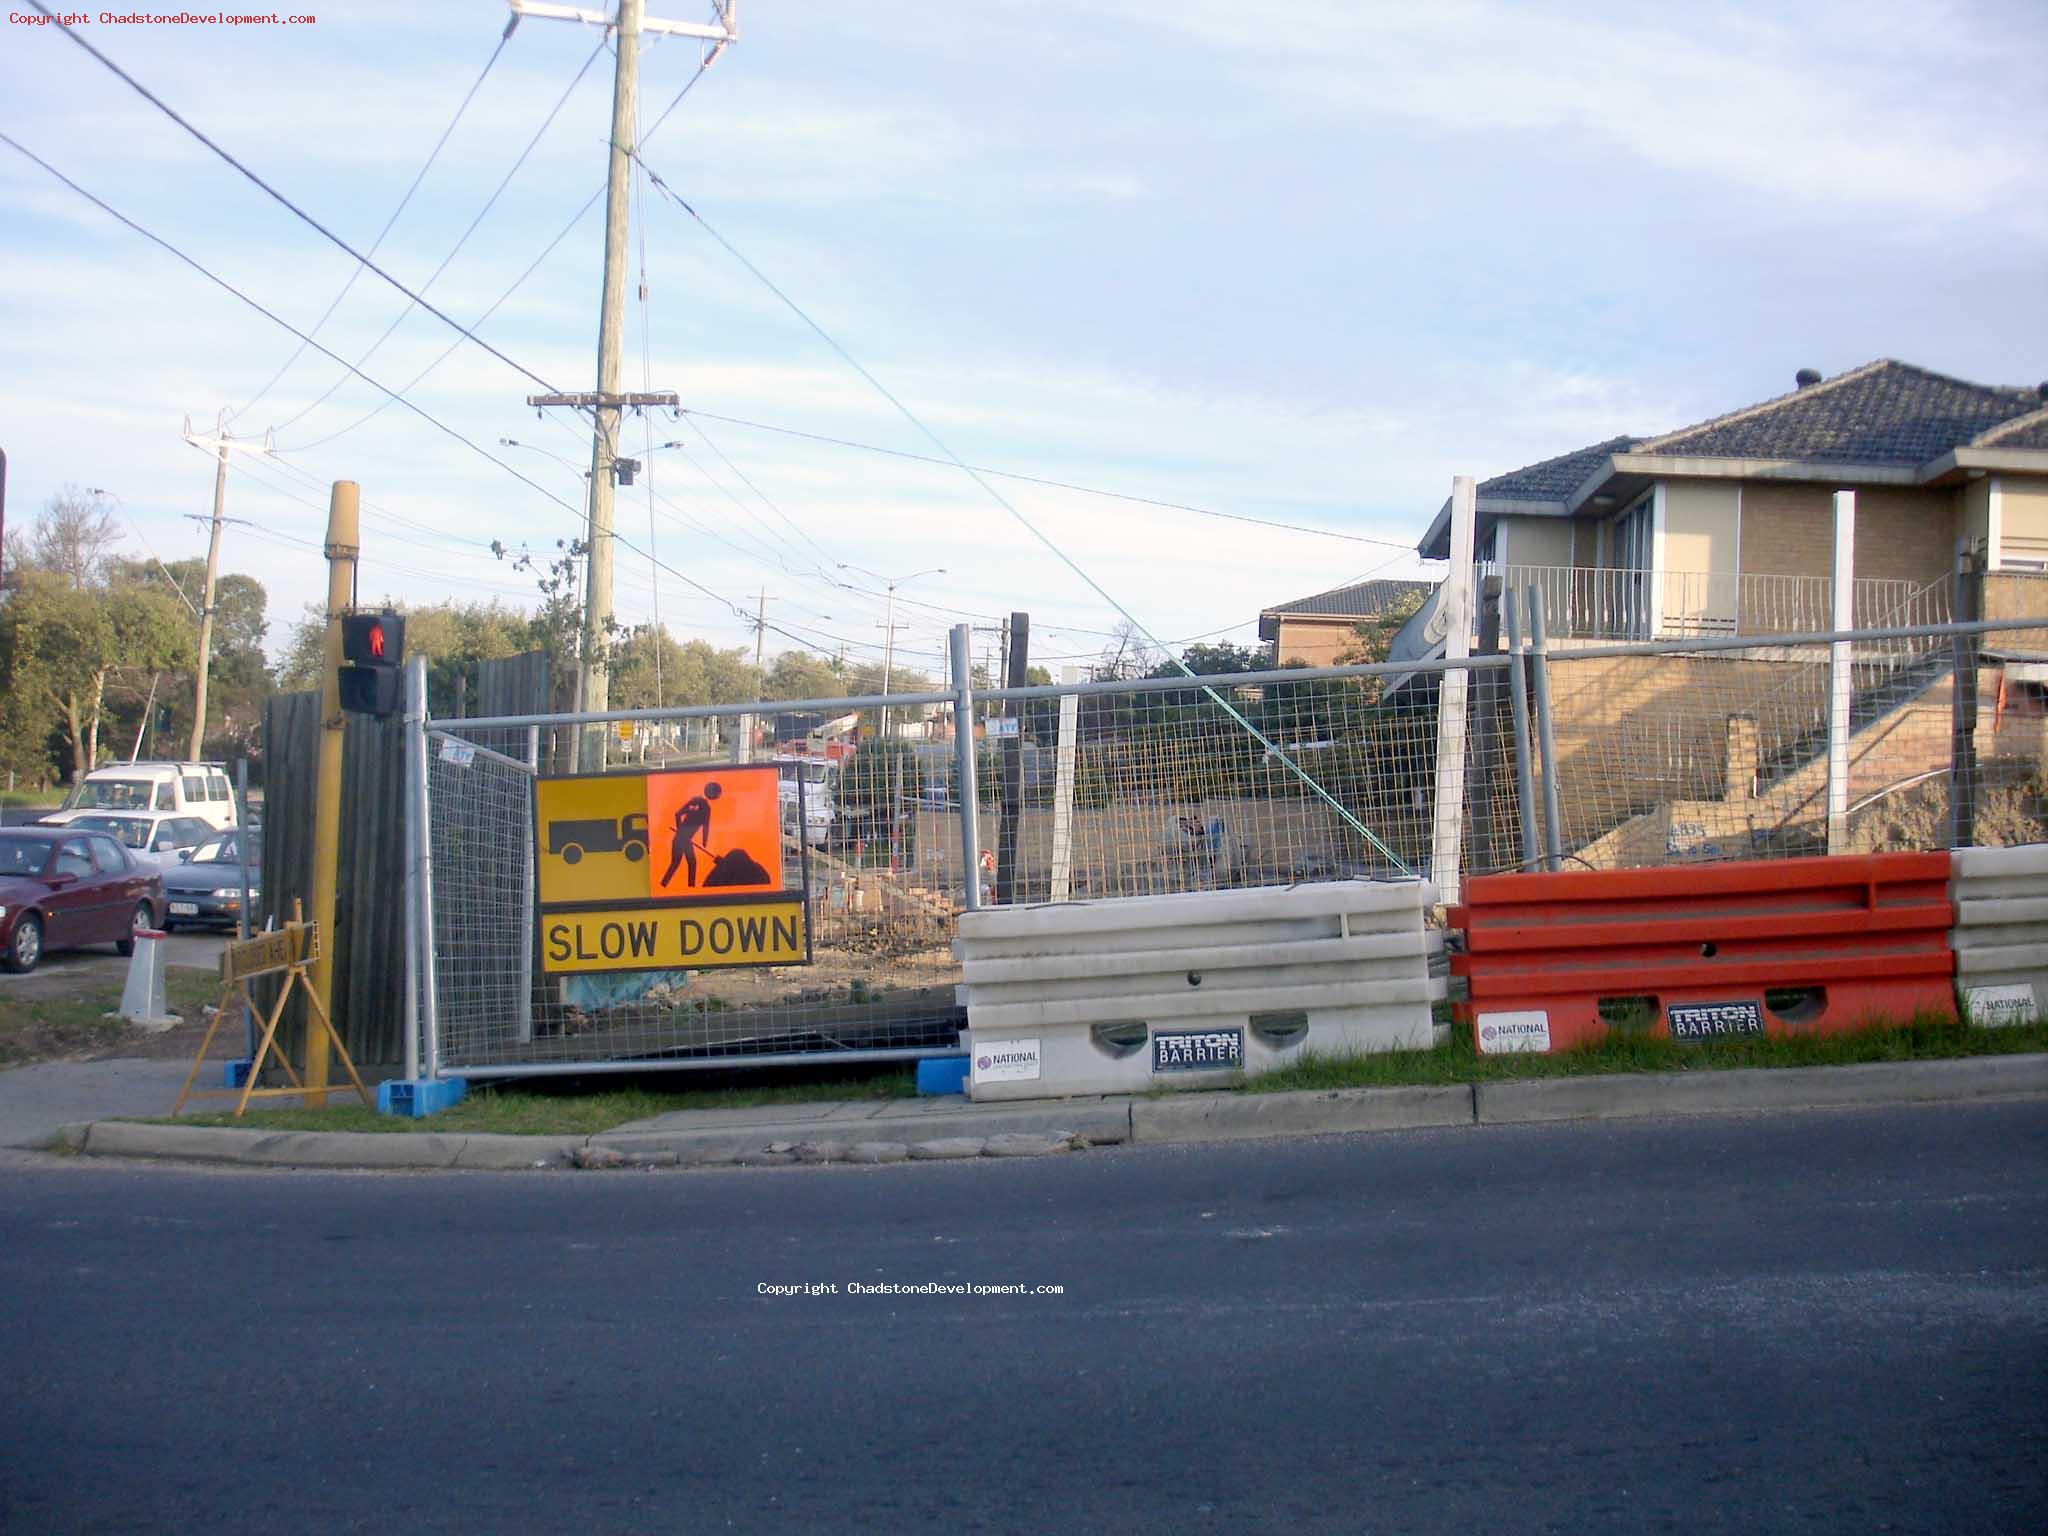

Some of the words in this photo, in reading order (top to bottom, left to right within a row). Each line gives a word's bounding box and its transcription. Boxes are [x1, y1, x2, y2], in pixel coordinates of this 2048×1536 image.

[549, 920, 658, 961] SLOW
[680, 915, 797, 956] DOWN
[1671, 1006, 1757, 1022] TRITON
[1498, 1023, 1546, 1035] NATIONAL
[1676, 1017, 1759, 1035] BARRIER
[1156, 1033, 1239, 1049] TRITON
[993, 1052, 1037, 1065] NATIONAL
[1160, 1046, 1239, 1063] BARRIER
